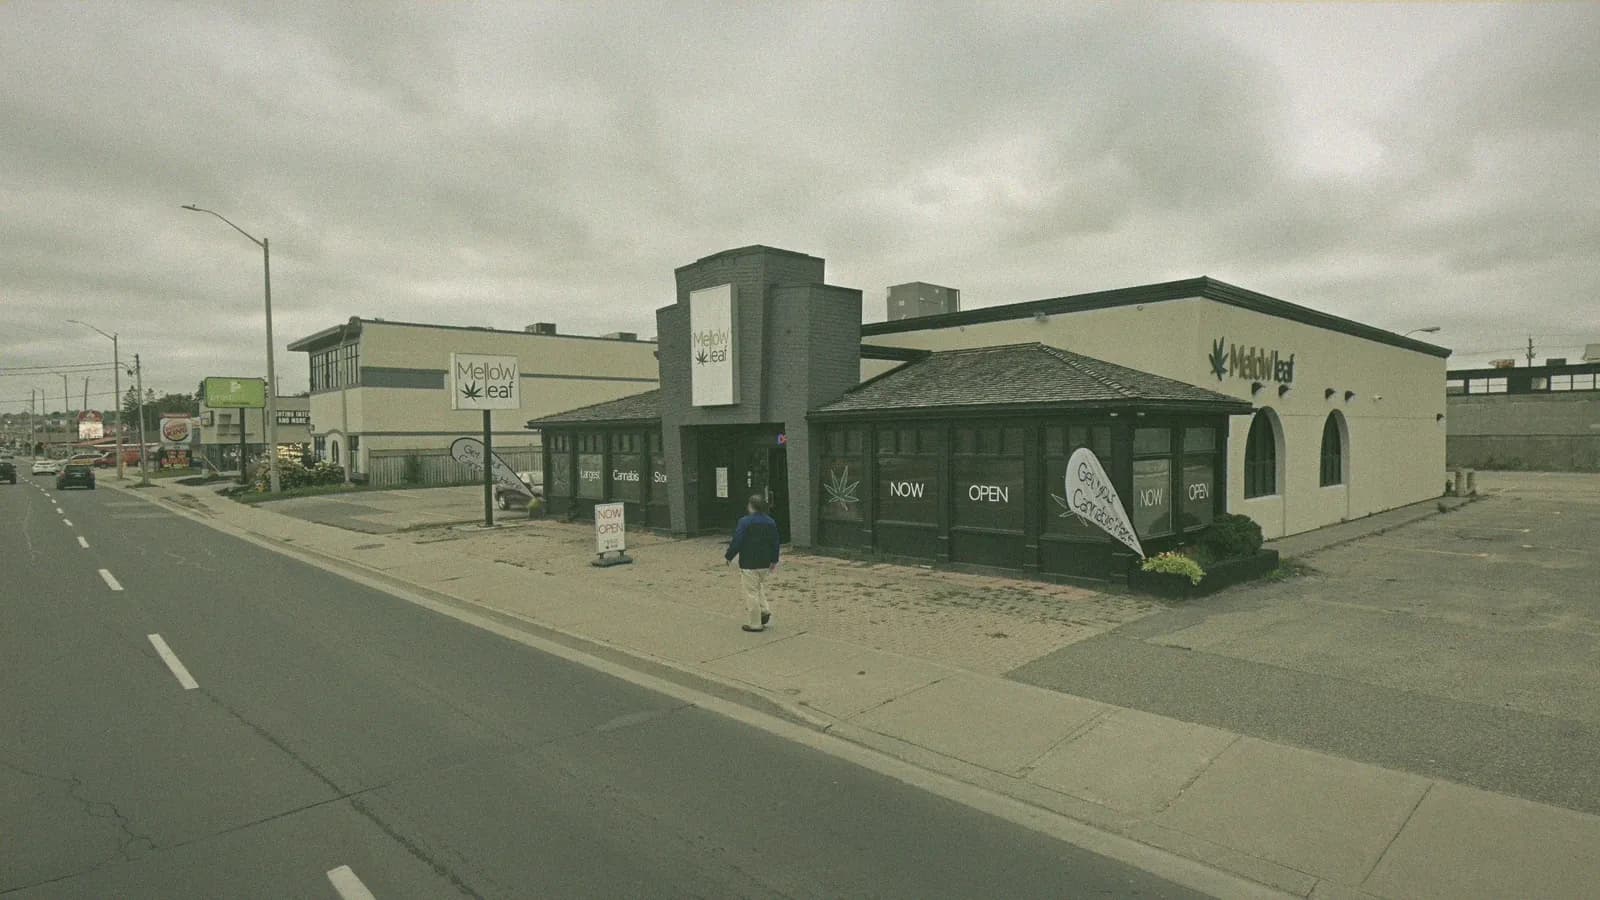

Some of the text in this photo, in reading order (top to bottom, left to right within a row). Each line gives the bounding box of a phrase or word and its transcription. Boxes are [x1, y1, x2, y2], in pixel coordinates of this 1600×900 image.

[1274, 349, 1295, 383] leaf
[484, 380, 514, 400] leaf
[580, 468, 601, 482] Largest
[612, 469, 641, 482] Cannabis
[890, 481, 1009, 503] NOW OPEN
[1140, 483, 1209, 508] NOW OPEN
[598, 508, 622, 520] NOW
[598, 522, 624, 535] OPEN
